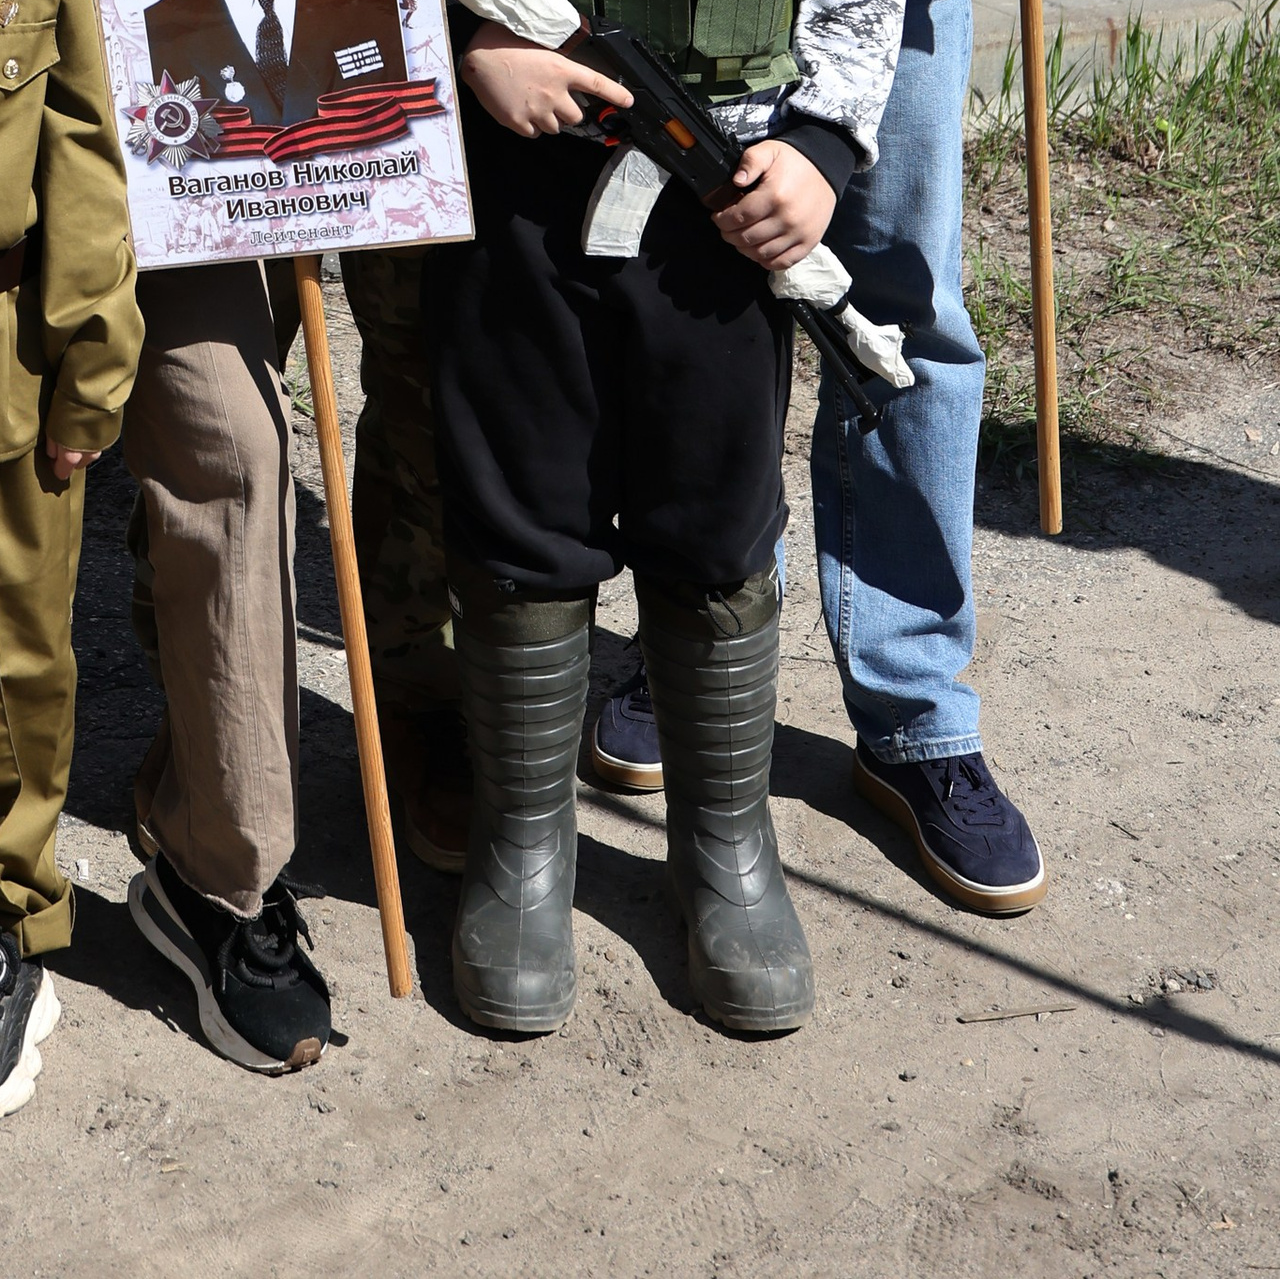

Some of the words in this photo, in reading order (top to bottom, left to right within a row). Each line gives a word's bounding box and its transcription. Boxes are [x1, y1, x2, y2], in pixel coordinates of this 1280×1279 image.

[168, 169, 284, 196] Ваганов
[293, 150, 418, 185] Николай
[225, 190, 368, 221] Иванович
[250, 224, 353, 244] Лейтенант
